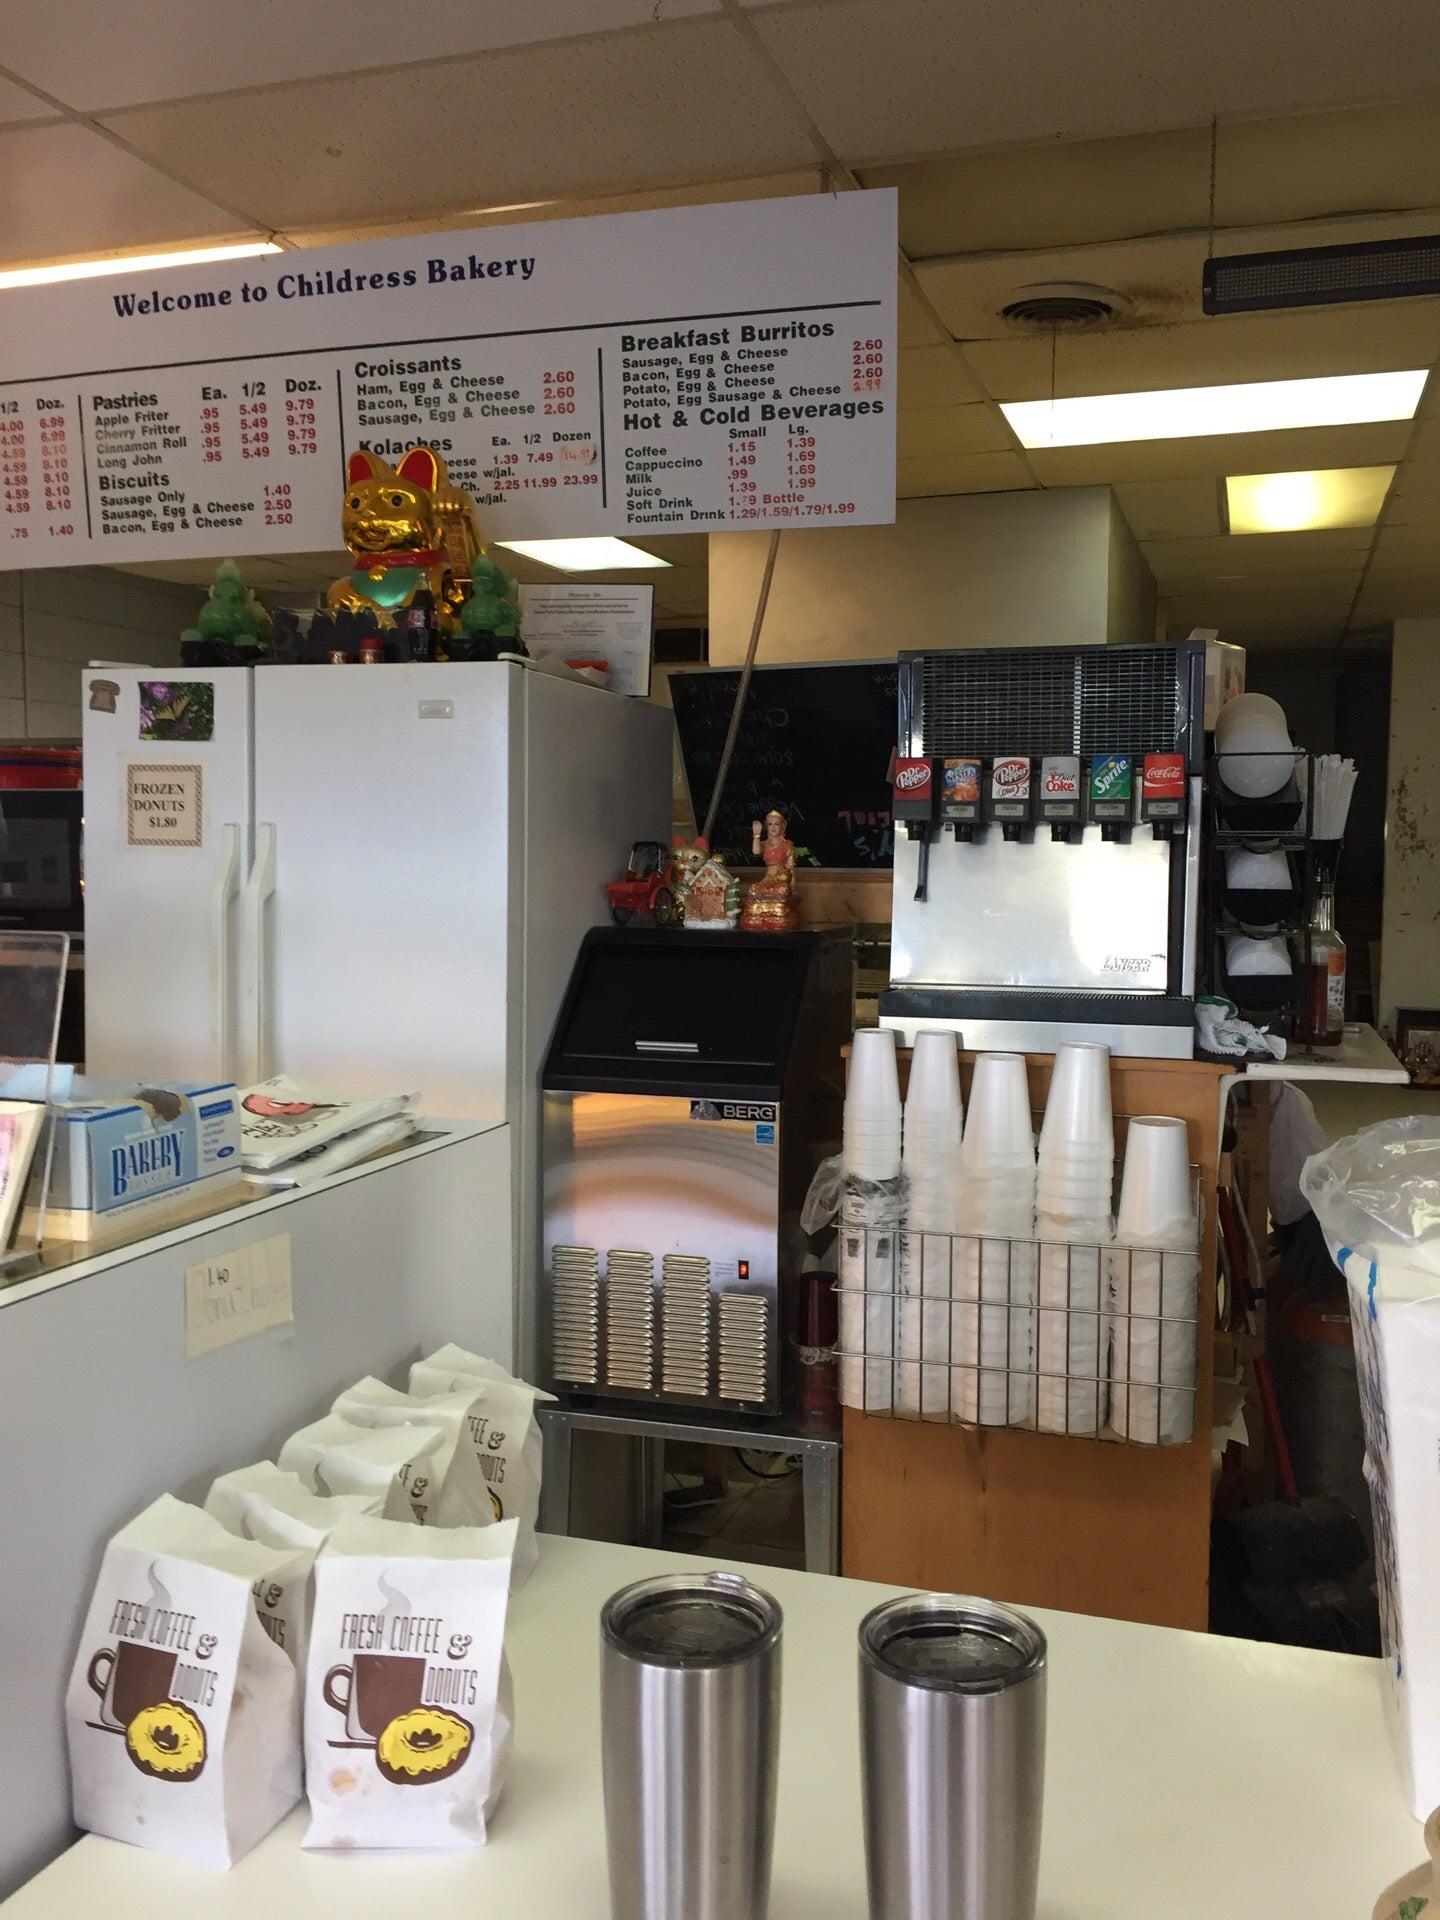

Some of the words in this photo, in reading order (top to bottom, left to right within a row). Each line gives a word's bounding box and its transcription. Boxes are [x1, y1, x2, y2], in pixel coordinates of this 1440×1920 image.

[113, 289, 232, 318] Welcome
[241, 283, 268, 303] to
[277, 269, 417, 300] Childress
[426, 256, 537, 284] Bakery
[622, 328, 730, 352] Breakfast
[741, 322, 834, 343] Burritos
[622, 356, 682, 368] Sausage,
[690, 352, 714, 365] Egg
[721, 351, 730, 361] &
[737, 347, 788, 359] Cheese
[853, 339, 883, 351] 2.60
[354, 356, 462, 378] Croissants
[623, 371, 669, 382] Bacon,
[676, 367, 700, 380] Egg
[706, 366, 716, 378] &
[724, 362, 774, 374] Cheese
[854, 353, 883, 365] 2.60
[357, 383, 392, 396] Ham,
[400, 381, 425, 393] Egg
[433, 378, 443, 390] &
[451, 374, 504, 388] Cheese
[543, 371, 574, 383] 2.60
[623, 384, 670, 395] Potato,
[677, 382, 701, 394] Egg
[707, 380, 716, 391] &
[725, 375, 775, 388] Cheese
[854, 367, 883, 378] 2.60
[93, 393, 158, 410] Pastries
[202, 387, 226, 400] Ea.
[242, 383, 266, 397] 1/2
[286, 379, 321, 393] Doz.
[358, 398, 407, 411] Bacon,
[415, 394, 441, 407] Egg
[448, 392, 458, 403] &
[466, 389, 520, 402] Cheese
[544, 387, 575, 398] 2.60
[624, 397, 670, 409] Potato,
[678, 394, 702, 406] Egg
[709, 390, 765, 403] Sausage
[772, 389, 782, 399] &
[790, 385, 841, 397] Cheese
[0, 400, 18, 414] 1/2
[36, 398, 64, 410] Doz.
[95, 414, 128, 429] Apple
[200, 408, 219, 419] .95
[240, 403, 266, 415] 5.49
[286, 399, 314, 411] 9.79
[359, 412, 422, 426] Sausage,
[430, 409, 456, 421] Egg
[463, 407, 473, 418] &
[481, 404, 535, 417] Cheese
[544, 403, 576, 414] 2.60
[624, 413, 661, 430] Hot
[672, 410, 688, 427] &
[700, 406, 750, 425] Cold
[761, 400, 884, 420] Beverages
[0, 421, 23, 431] 4.00
[96, 429, 135, 441] Cherry
[141, 425, 181, 435] Fritter
[201, 423, 220, 433] .95
[241, 418, 267, 430] 5.49
[287, 414, 315, 426] 9.79
[729, 427, 766, 439] Small
[789, 425, 809, 436] Lg.
[97, 443, 157, 455] Cinnamon
[163, 438, 186, 448] Roll
[202, 437, 221, 448] .95
[241, 432, 269, 444] 5.49
[288, 428, 316, 440] 9.79
[492, 436, 511, 446] Ea.
[524, 434, 541, 445] 1/2
[553, 431, 591, 442] Dozen
[625, 447, 667, 457] Coffee
[728, 442, 756, 452] 1.15
[787, 438, 815, 448] 1.39
[97, 456, 126, 469] Long
[132, 454, 162, 466] John
[203, 451, 222, 462] .95
[242, 447, 270, 459] 5.49
[288, 443, 317, 455] 9.79
[493, 454, 518, 465] 1.39
[527, 452, 553, 463] 7.49
[625, 457, 703, 472] Cappuccino
[728, 455, 756, 466] 1.49
[787, 451, 815, 461] 1.69
[100, 472, 169, 490] Biscuits
[461, 483, 480, 492] Ch.
[494, 480, 519, 491] 2.25
[523, 478, 557, 489] 11.99
[563, 475, 598, 486] 23.99
[626, 473, 652, 484] Milk
[728, 470, 748, 480] .99
[787, 465, 815, 475] 1.69
[101, 494, 152, 507] Sausage
[158, 491, 185, 503] Only
[263, 484, 291, 496] 1.40
[626, 487, 661, 497] Juice
[729, 482, 756, 492] 1.39
[788, 479, 816, 489] 1.99
[102, 509, 156, 520] Sausage,
[163, 505, 185, 517] Egg
[193, 504, 201, 514] &
[208, 501, 254, 513] Cheese
[264, 499, 292, 511] 2.50
[627, 499, 651, 510] Soft
[659, 498, 693, 508] Drink
[763, 493, 805, 503] Bottle
[103, 522, 147, 535] Bacon,
[152, 519, 174, 533] Egg
[181, 519, 189, 529] &
[196, 516, 243, 528] Cheese
[265, 514, 293, 525] 2.50
[628, 511, 684, 523] Fountain
[690, 510, 725, 520] Drink
[11, 528, 28, 538] .75
[48, 524, 73, 536] 1.40
[900, 770, 929, 789] Pepper
[907, 767, 919, 776] Dr
[1000, 768, 1028, 785] Pepper
[1008, 765, 1019, 773] Dr
[1094, 760, 1128, 794] Sprite
[134, 783, 184, 795] FROZEN
[1046, 780, 1074, 792] Coke
[134, 800, 185, 811] DONUTS
[150, 817, 177, 828] $1.80
[724, 1105, 773, 1119] BERG
[112, 1131, 183, 1196] BAKERY
[109, 1599, 149, 1639] FRESH
[149, 1609, 197, 1651] COFFEE
[196, 1634, 218, 1660] &
[341, 1613, 384, 1650] FRESH
[390, 1615, 443, 1654] COFFEE
[447, 1634, 473, 1660] &
[171, 1663, 218, 1707] DONUTS
[425, 1667, 478, 1706] DONUTS
